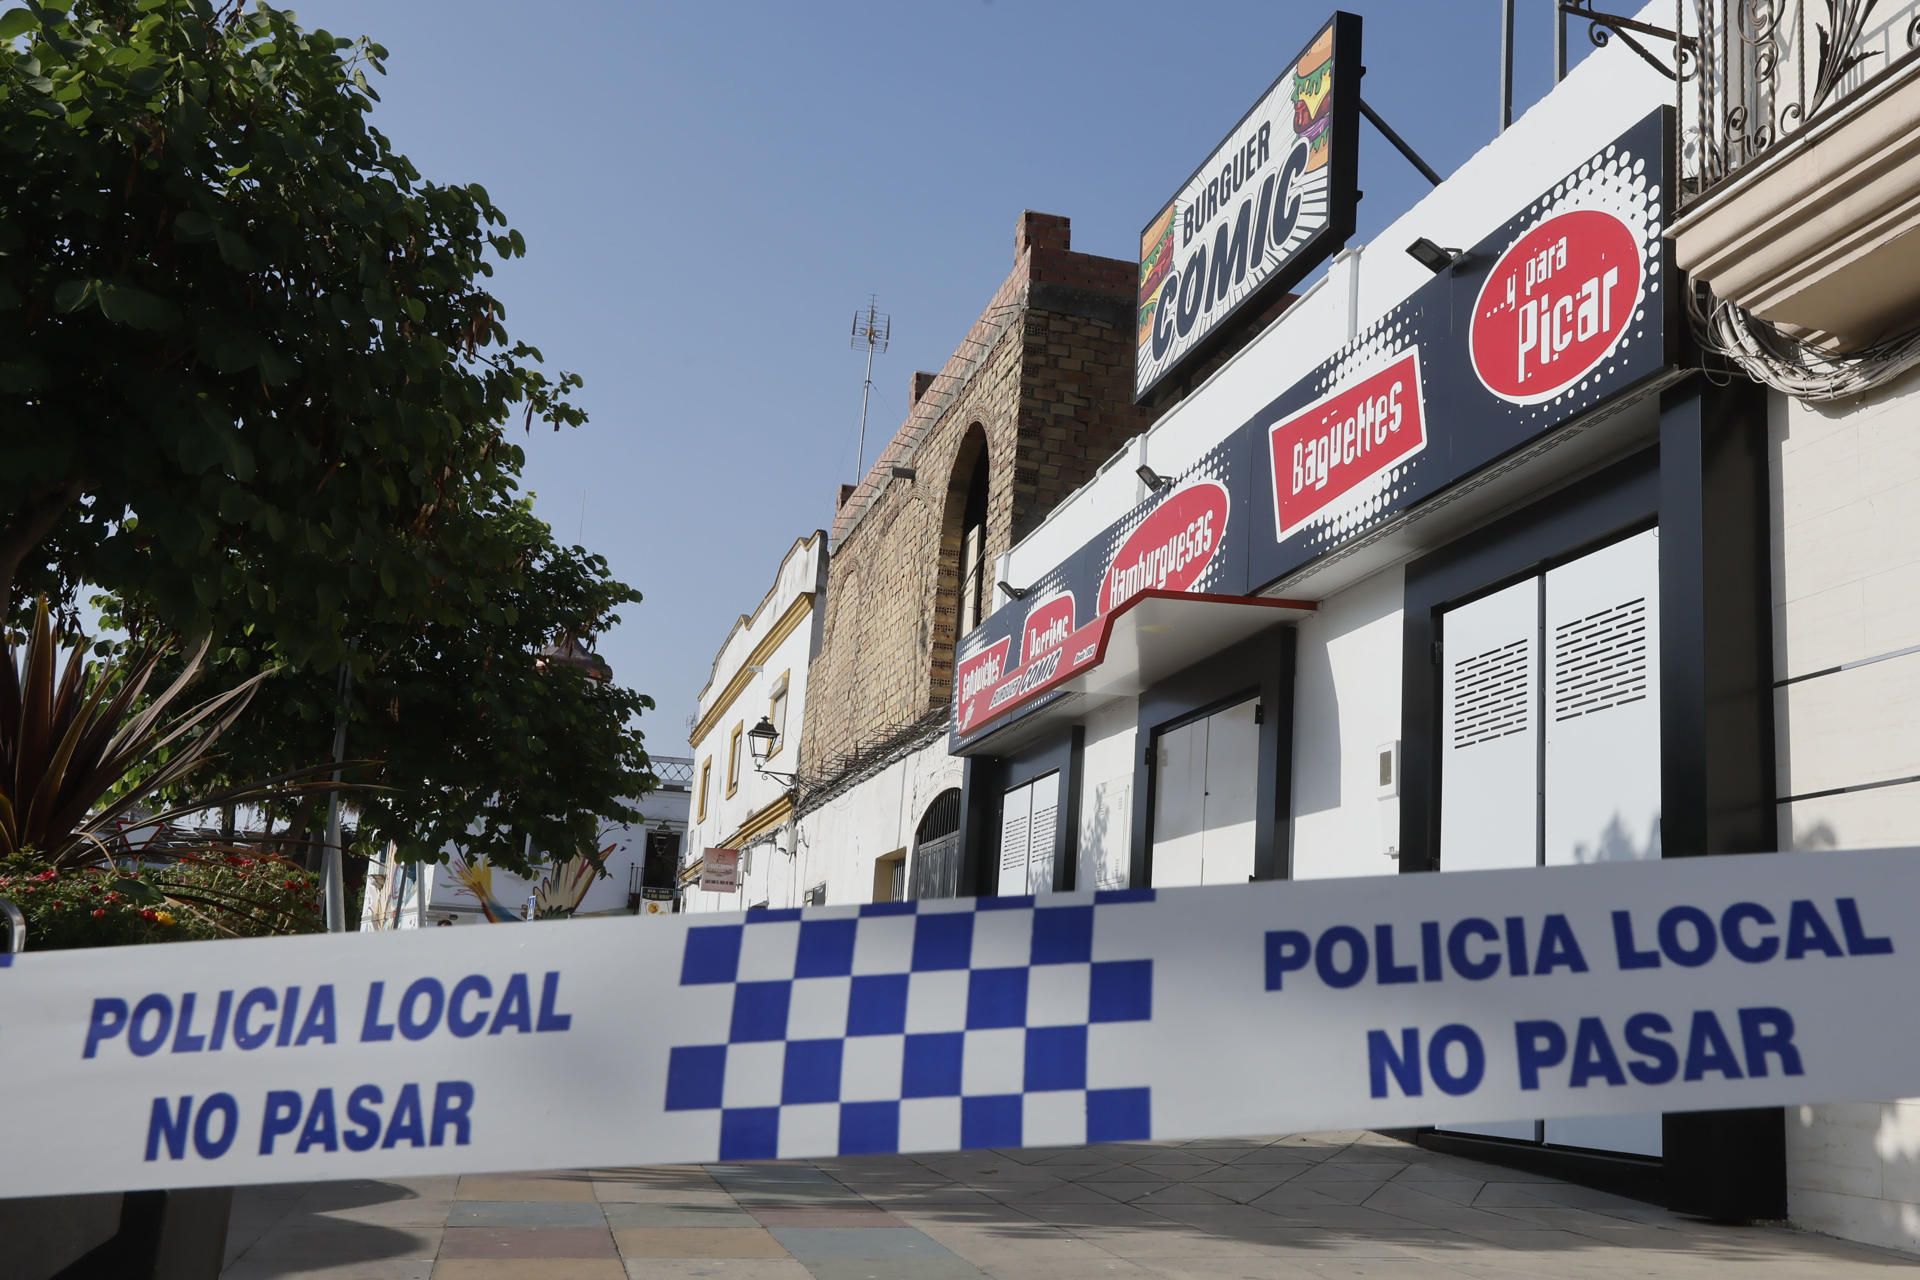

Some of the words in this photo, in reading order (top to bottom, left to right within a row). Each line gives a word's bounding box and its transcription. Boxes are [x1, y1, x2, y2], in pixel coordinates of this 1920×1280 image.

[1183, 120, 1271, 249] BURGUER
[1152, 140, 1309, 363] COMIC
[1525, 236, 1568, 296] para
[1517, 266, 1619, 384] Picar
[1292, 381, 1403, 496] Bagüettes
[1110, 509, 1214, 609] Hamburguesas
[1020, 648, 1062, 694] COMIC
[1264, 913, 1590, 992] POLICIA
[1610, 897, 1895, 971] LOCAL
[82, 984, 336, 1059] POLICIA
[360, 971, 573, 1041] LOCAL
[1366, 1023, 1487, 1099] NO
[1514, 1006, 1806, 1091] PASAR
[143, 1092, 240, 1162] NO
[258, 1080, 475, 1155] PASAR
